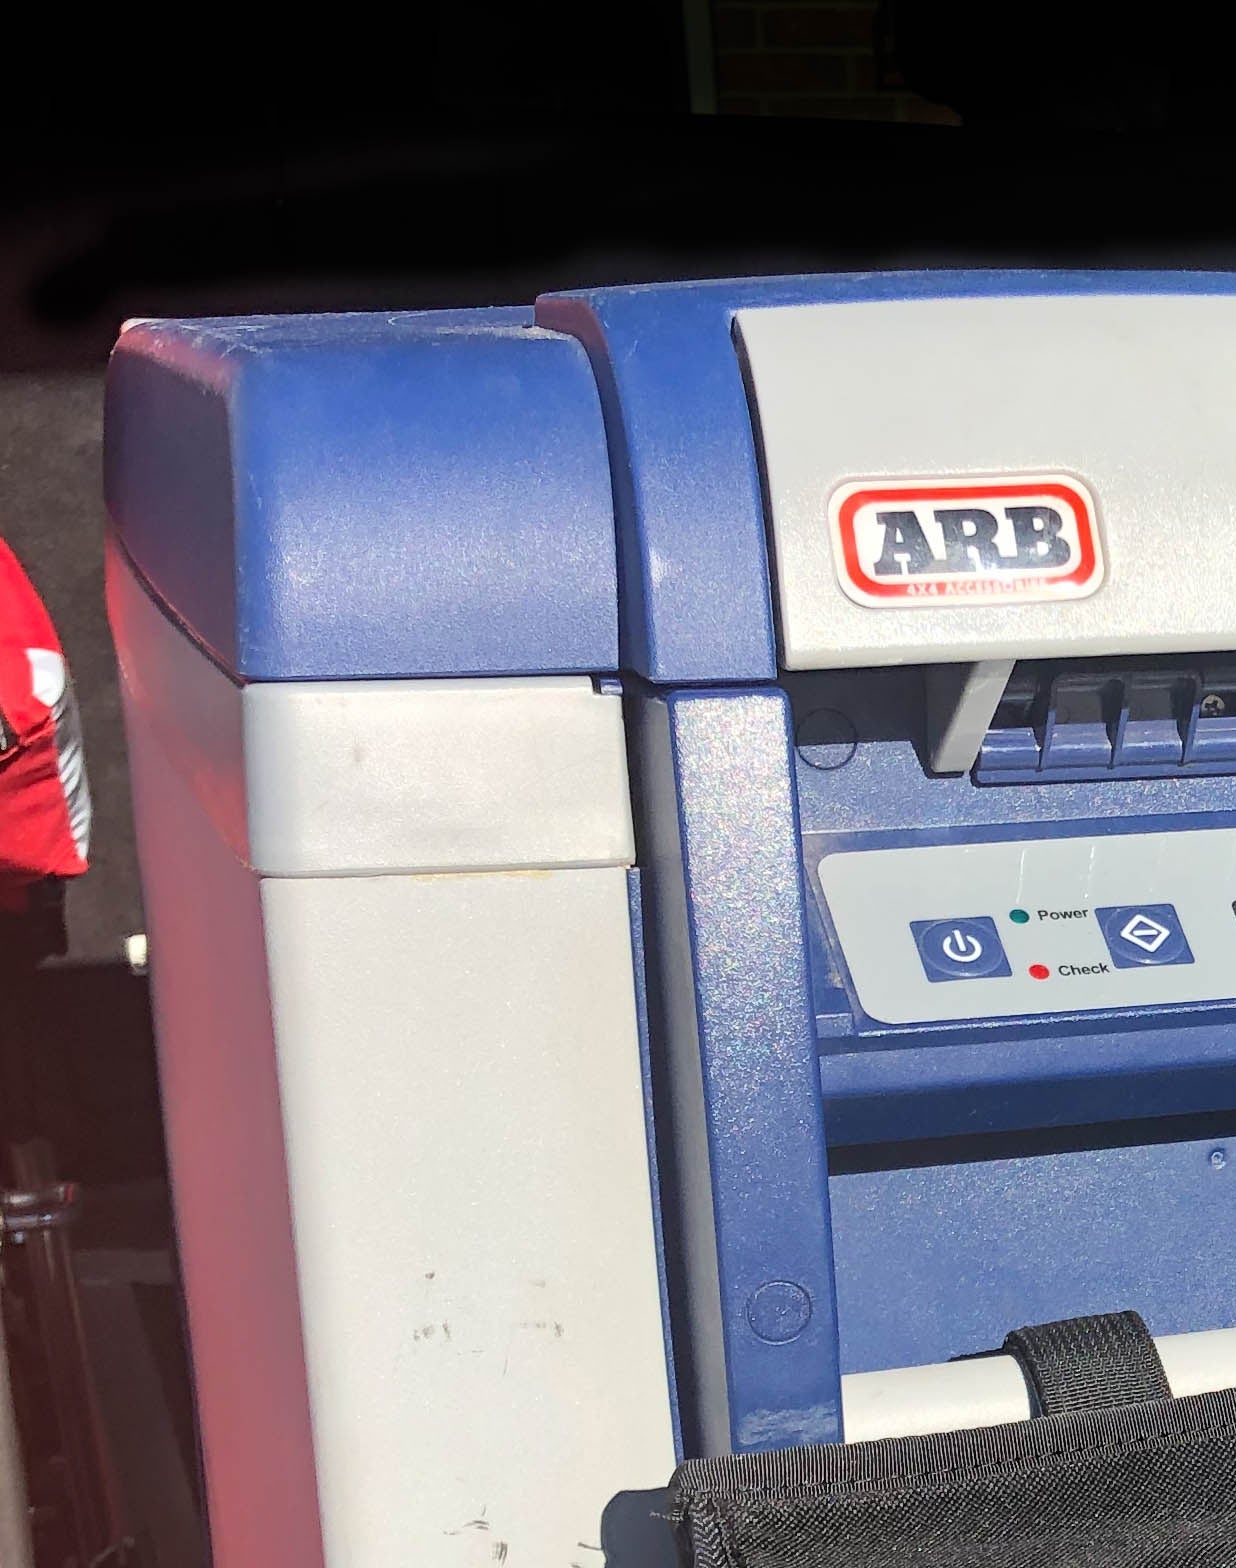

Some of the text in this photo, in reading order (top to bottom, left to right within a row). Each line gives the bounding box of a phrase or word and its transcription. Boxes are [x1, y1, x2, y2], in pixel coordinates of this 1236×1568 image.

[873, 506, 1071, 576] ARB
[1037, 908, 1089, 921] Power
[1058, 962, 1110, 977] Check
